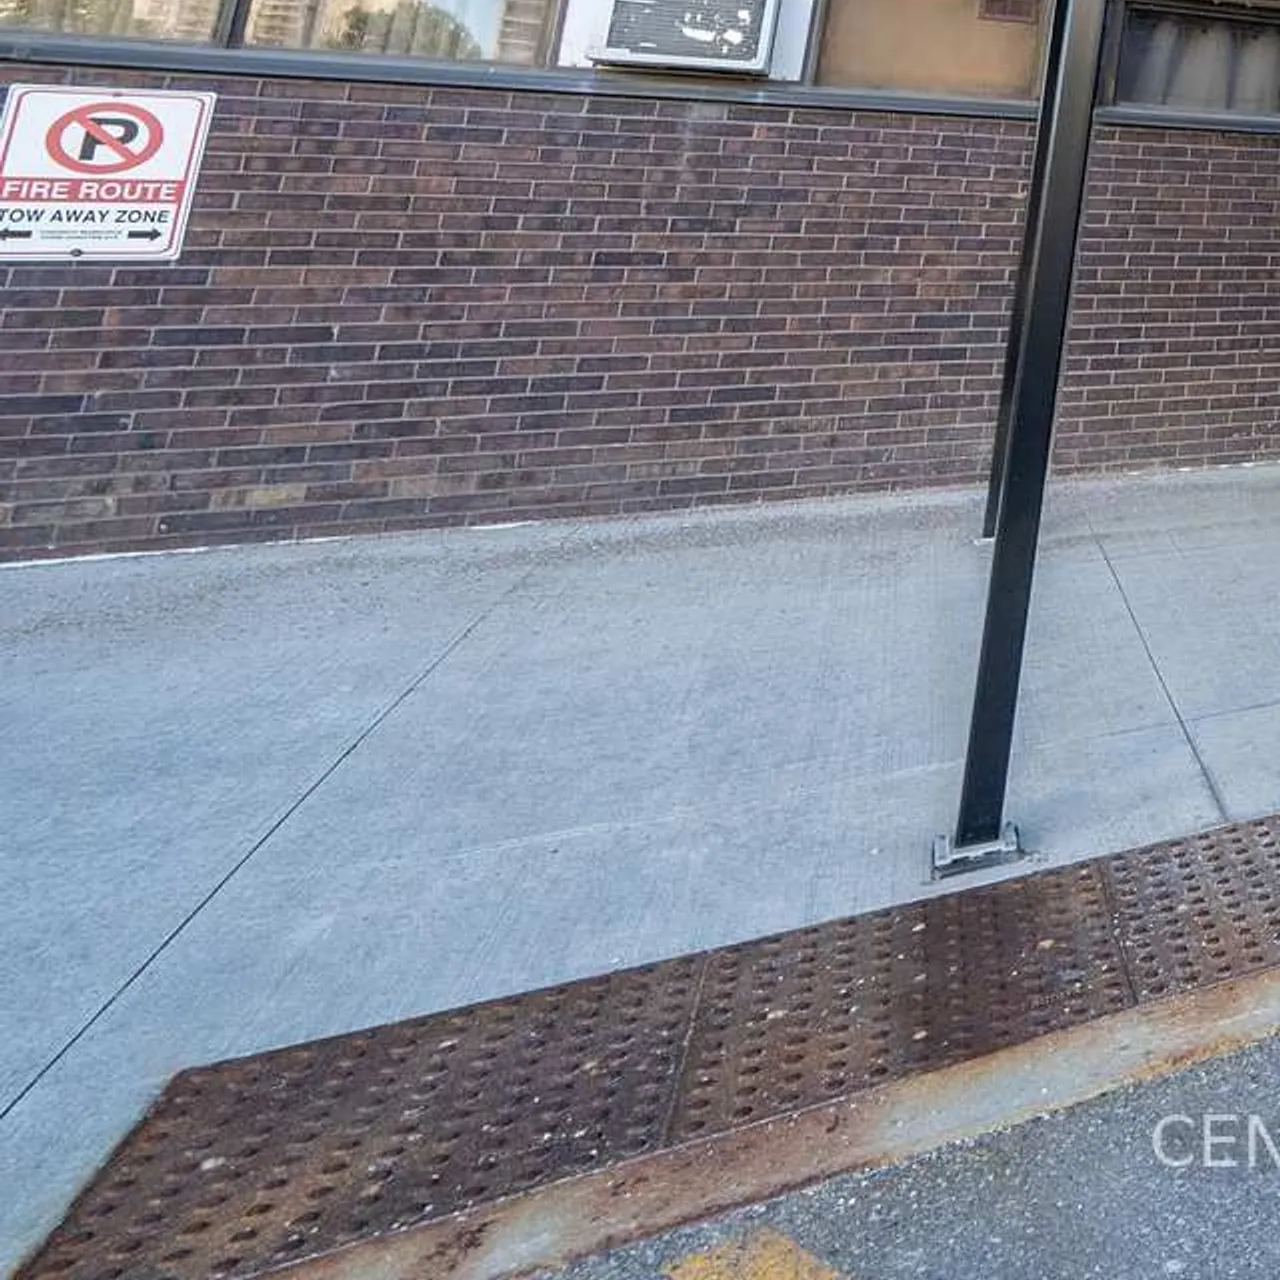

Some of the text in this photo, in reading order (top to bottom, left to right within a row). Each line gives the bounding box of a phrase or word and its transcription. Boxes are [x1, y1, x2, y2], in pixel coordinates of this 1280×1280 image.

[2, 180, 178, 200] FIRE ROUTE
[0, 208, 170, 223] TOW AWAY ZONE
